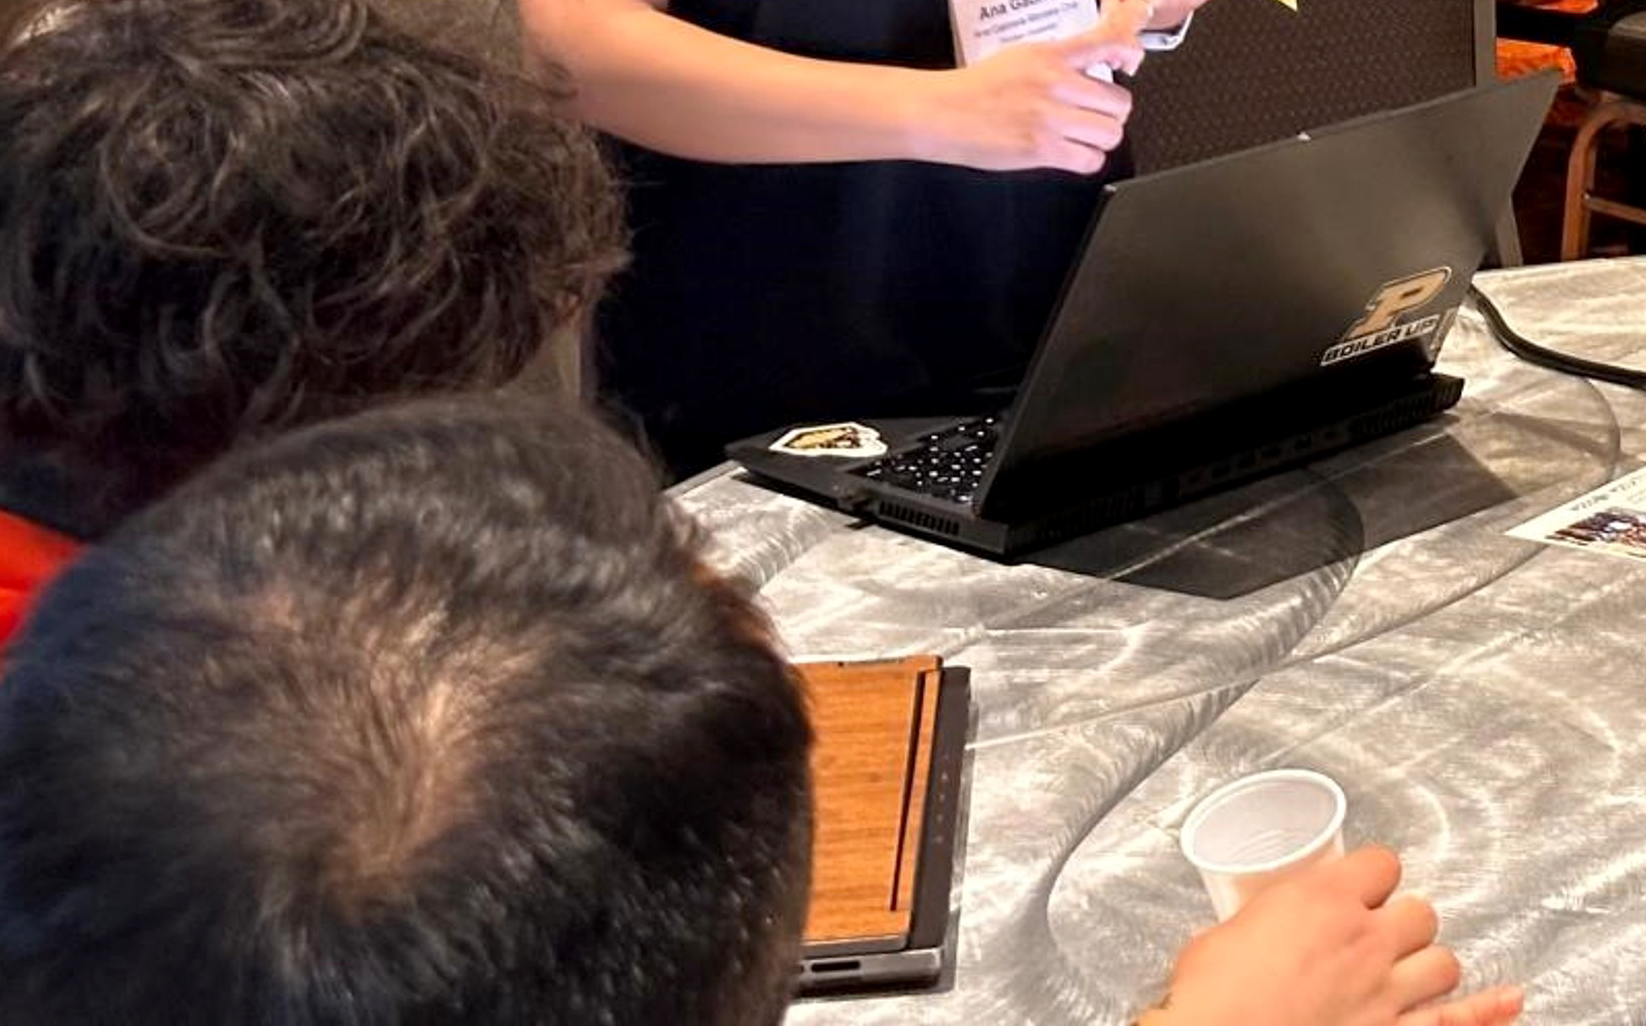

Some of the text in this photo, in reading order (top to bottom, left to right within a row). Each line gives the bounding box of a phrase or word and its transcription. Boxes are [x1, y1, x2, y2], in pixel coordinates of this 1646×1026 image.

[979, 2, 1007, 20] Ana
[1324, 317, 1438, 361] BOILER UP
